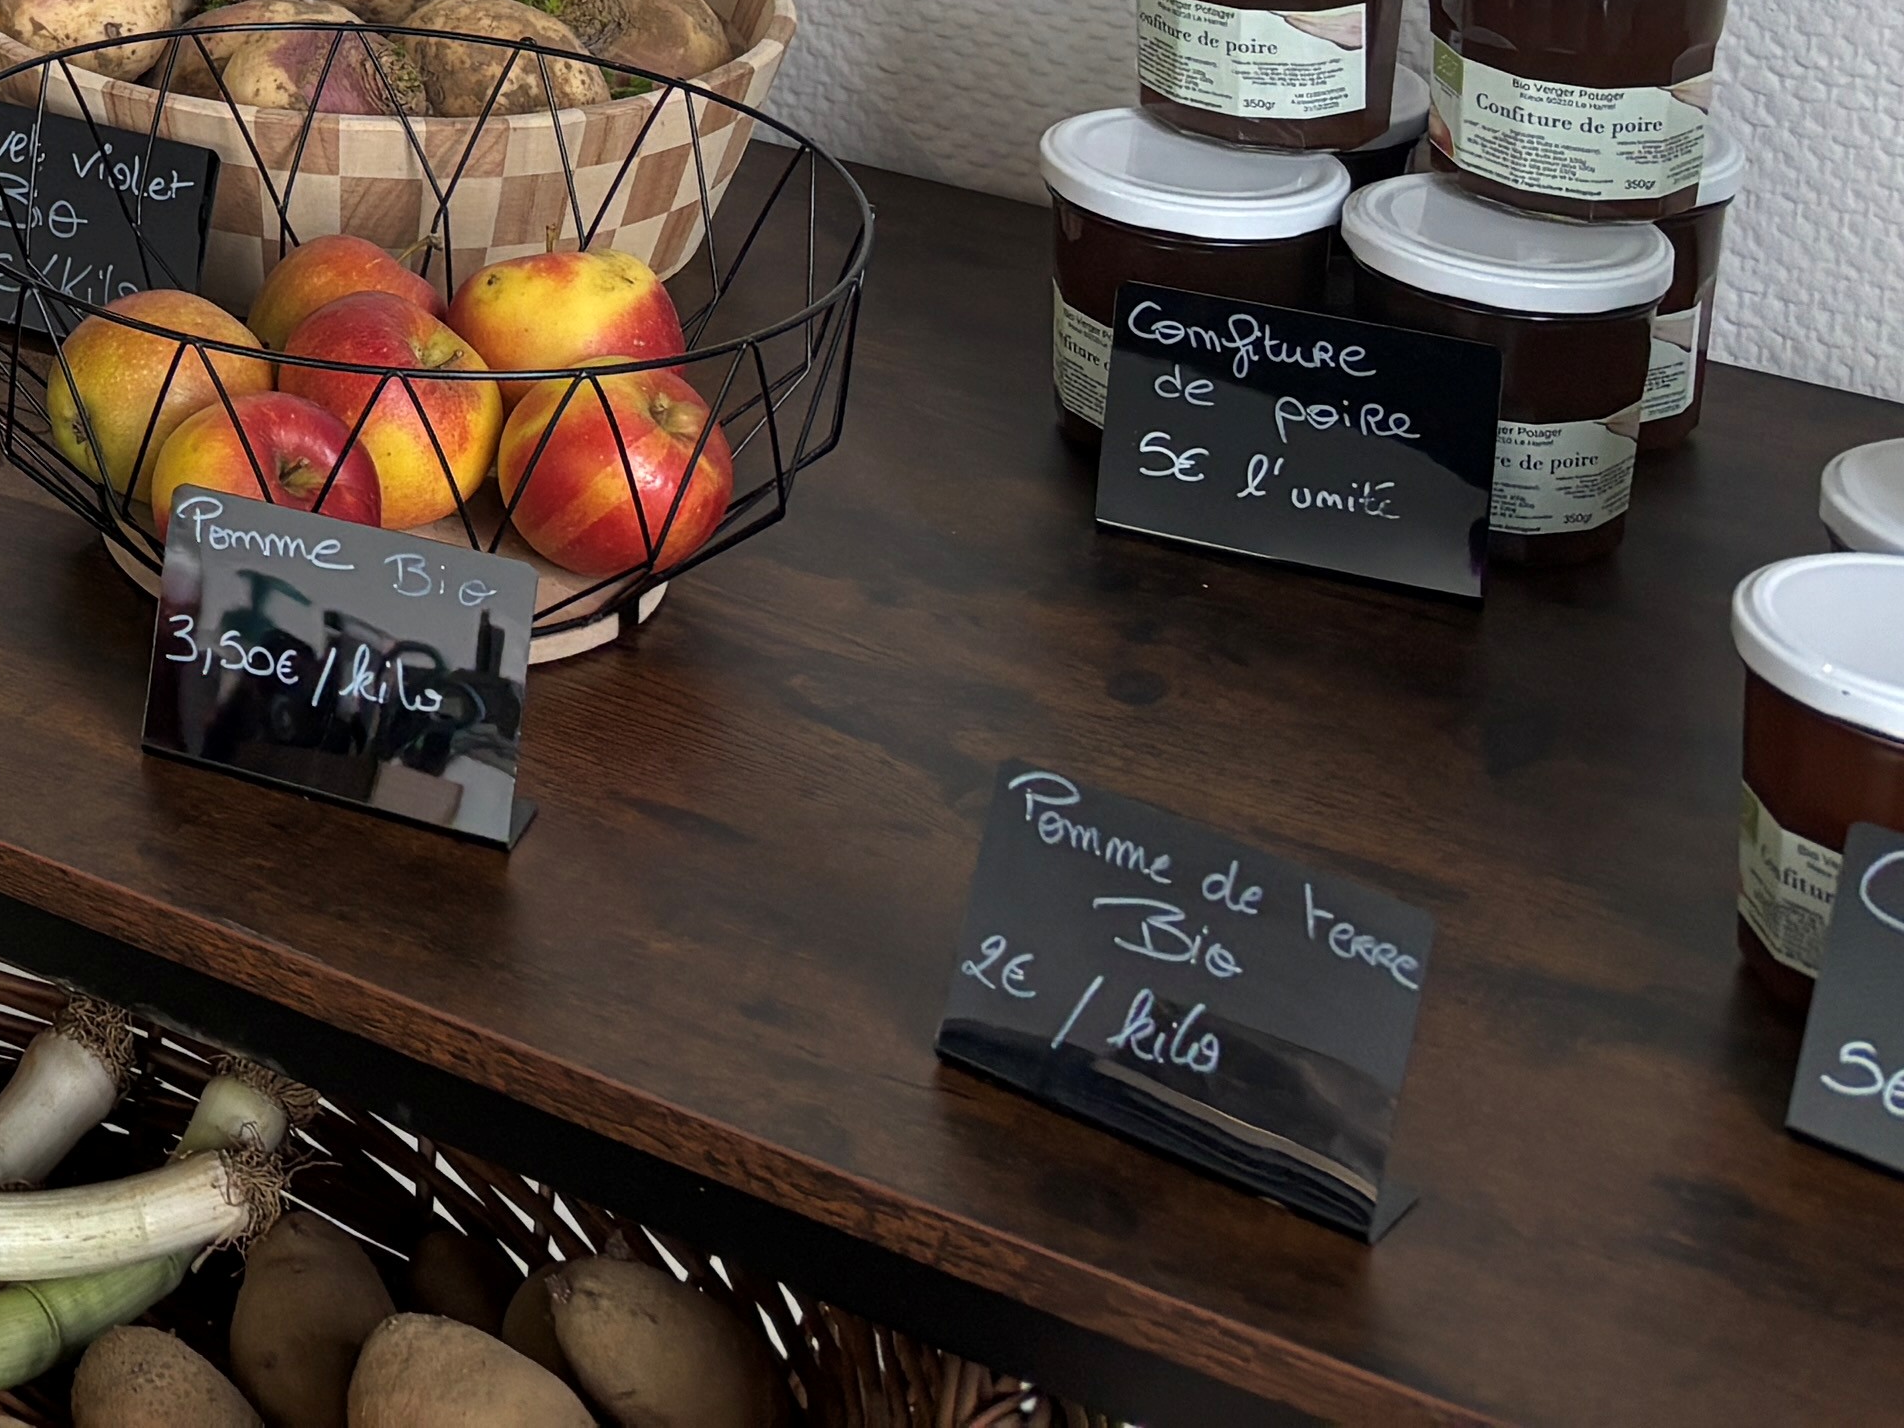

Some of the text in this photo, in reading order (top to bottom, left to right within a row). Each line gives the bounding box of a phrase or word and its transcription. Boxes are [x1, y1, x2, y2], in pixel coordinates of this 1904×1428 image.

[1140, 11, 1278, 56] onfiture de poire
[1195, 4, 1236, 20] Potager
[1243, 97, 1276, 113] 350gr
[1513, 77, 1625, 104] Bio Verger Potager
[1476, 93, 1572, 132] Confiture
[1580, 118, 1604, 134] de
[1612, 117, 1663, 144] poire
[1063, 334, 1100, 366] fiture
[1154, 363, 1215, 407] de
[1275, 395, 1422, 444] poire
[1139, 430, 1210, 482] 5€
[1519, 452, 1599, 475] de poire
[176, 496, 498, 606] Pomme Bio
[165, 614, 299, 685] 3,50€
[1007, 771, 1420, 991] Pomme de terre
[1092, 897, 1244, 979] Bio
[961, 934, 1037, 999] 2€
